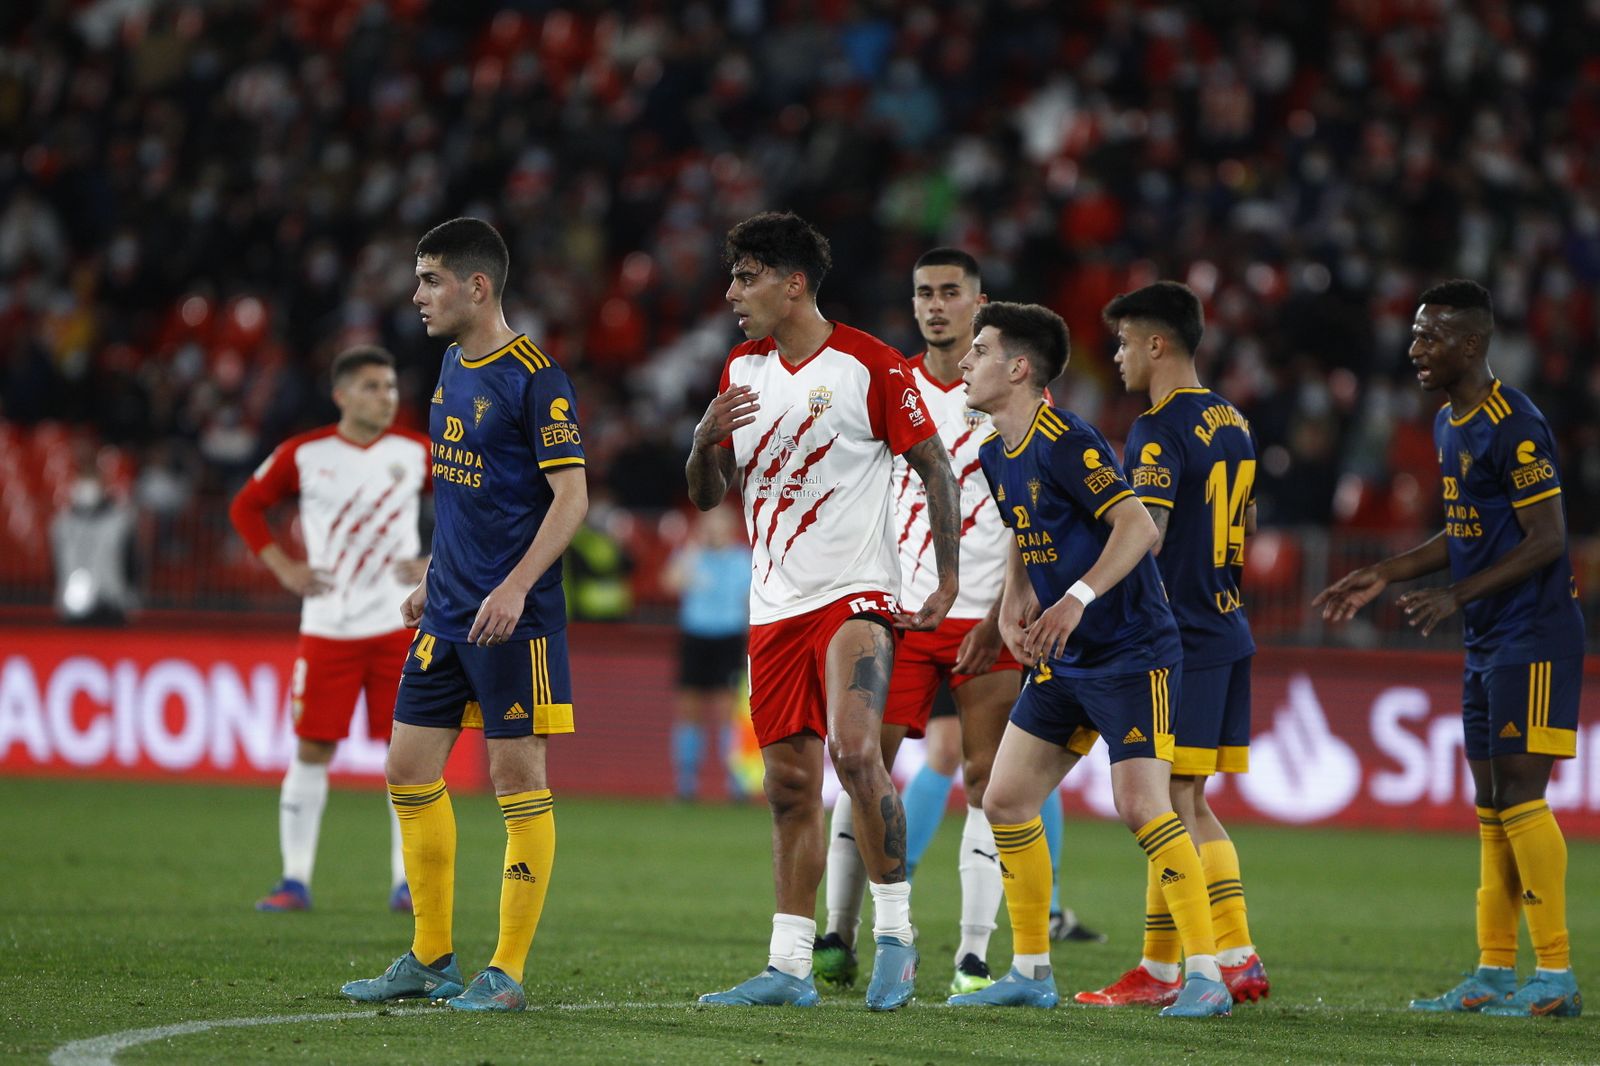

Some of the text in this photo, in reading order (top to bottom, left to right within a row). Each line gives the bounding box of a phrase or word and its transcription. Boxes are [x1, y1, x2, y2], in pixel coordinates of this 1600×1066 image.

[542, 428, 581, 447] EBRO
[1133, 471, 1171, 488] EBRO
[1512, 464, 1554, 490] EBRO
[782, 486, 822, 499] Centres
[1205, 459, 1257, 568] 14
[503, 712, 529, 721] adidas
